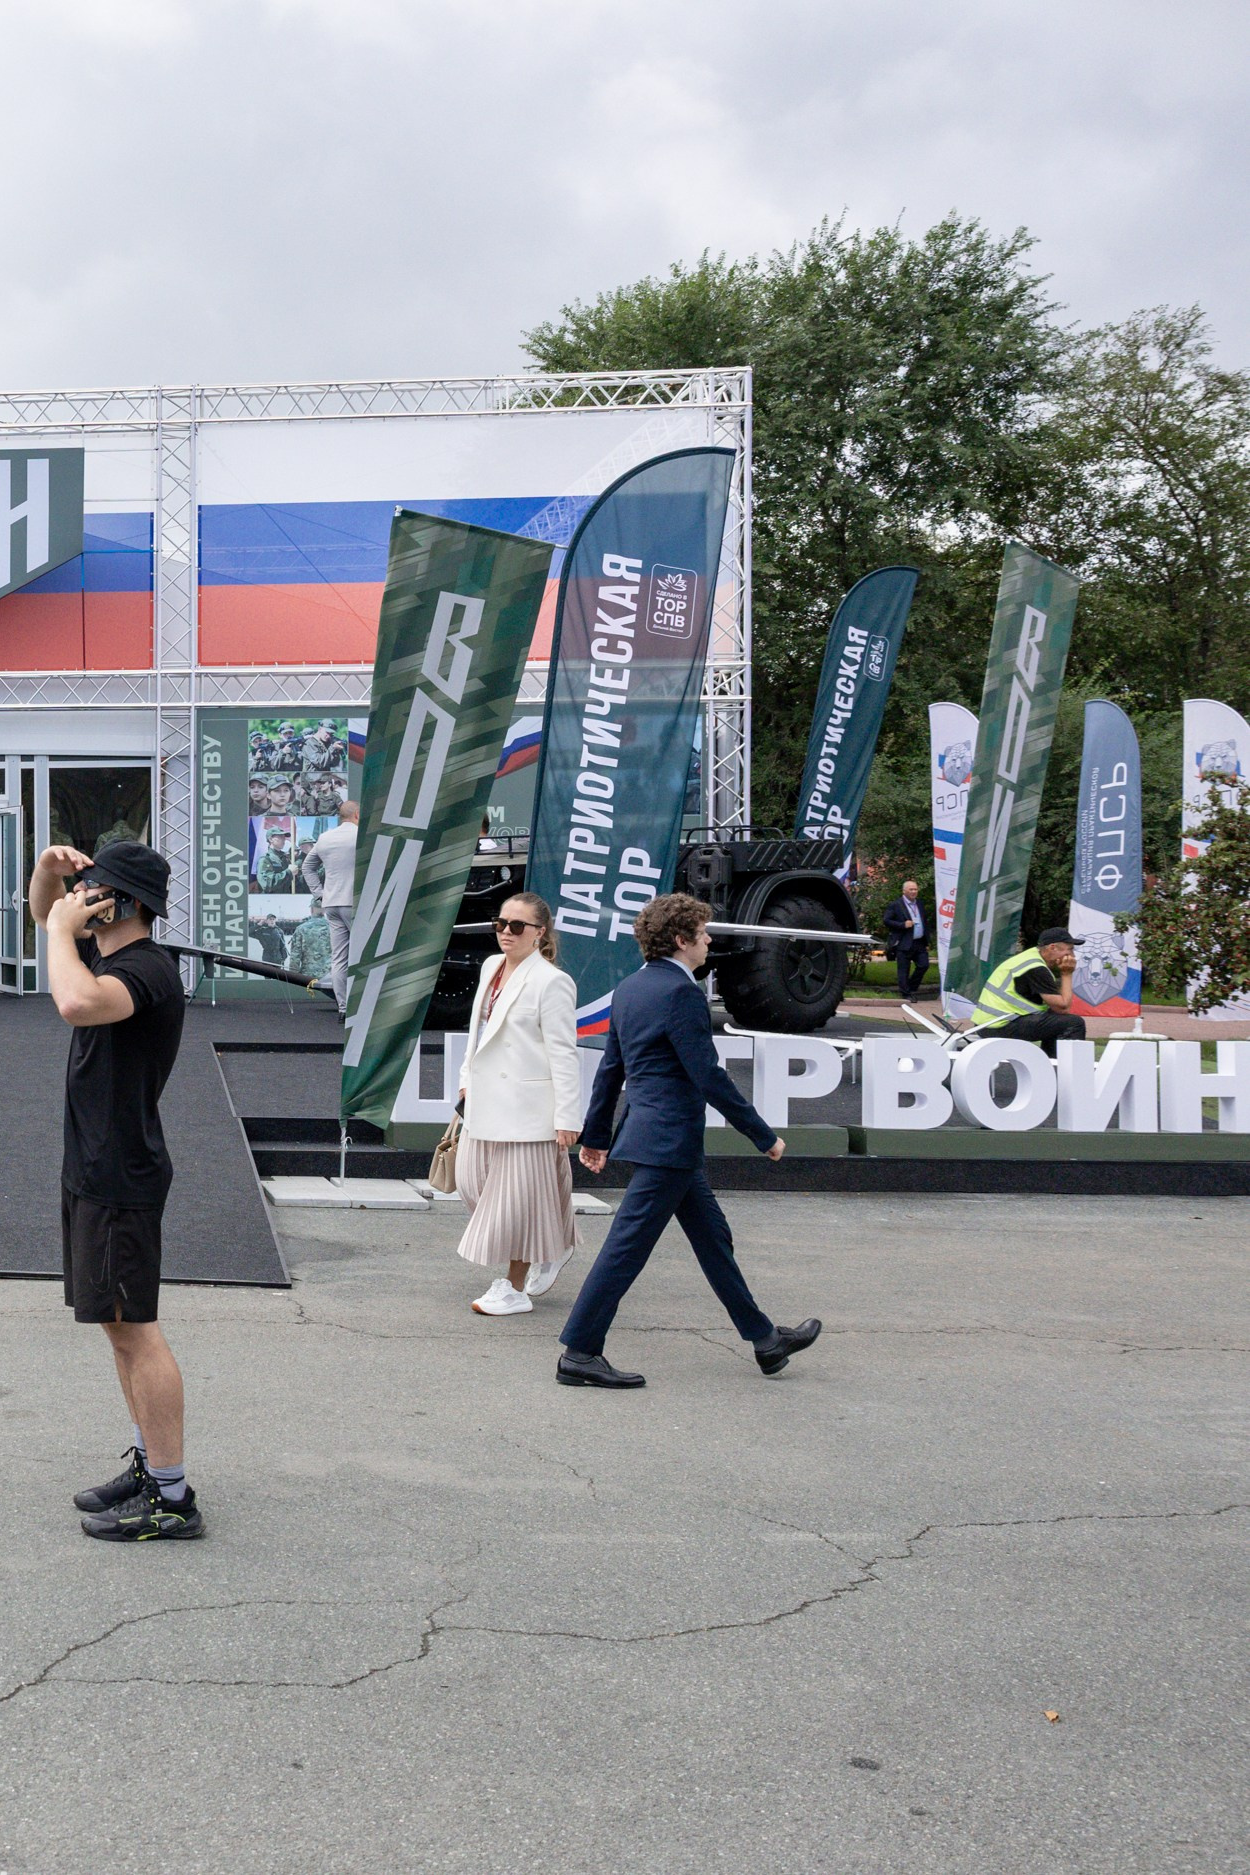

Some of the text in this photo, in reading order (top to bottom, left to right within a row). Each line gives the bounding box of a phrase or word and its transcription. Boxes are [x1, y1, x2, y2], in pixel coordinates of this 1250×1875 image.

[653, 612, 686, 627] СПВ
[655, 597, 687, 613] ТОР
[656, 590, 682, 600] СДЕЛАНО
[554, 553, 643, 937] ПАТРИОТИЧЕСКАЯ
[803, 625, 869, 840] АТРИОТИЧЕСКАЯ
[974, 604, 1047, 962] ВОИН
[203, 734, 222, 885] ОТЕЧЕСТВУ
[225, 843, 248, 952] НАРОДУ
[608, 846, 662, 941] ТОР
[862, 1037, 1250, 1132] ВОИН
